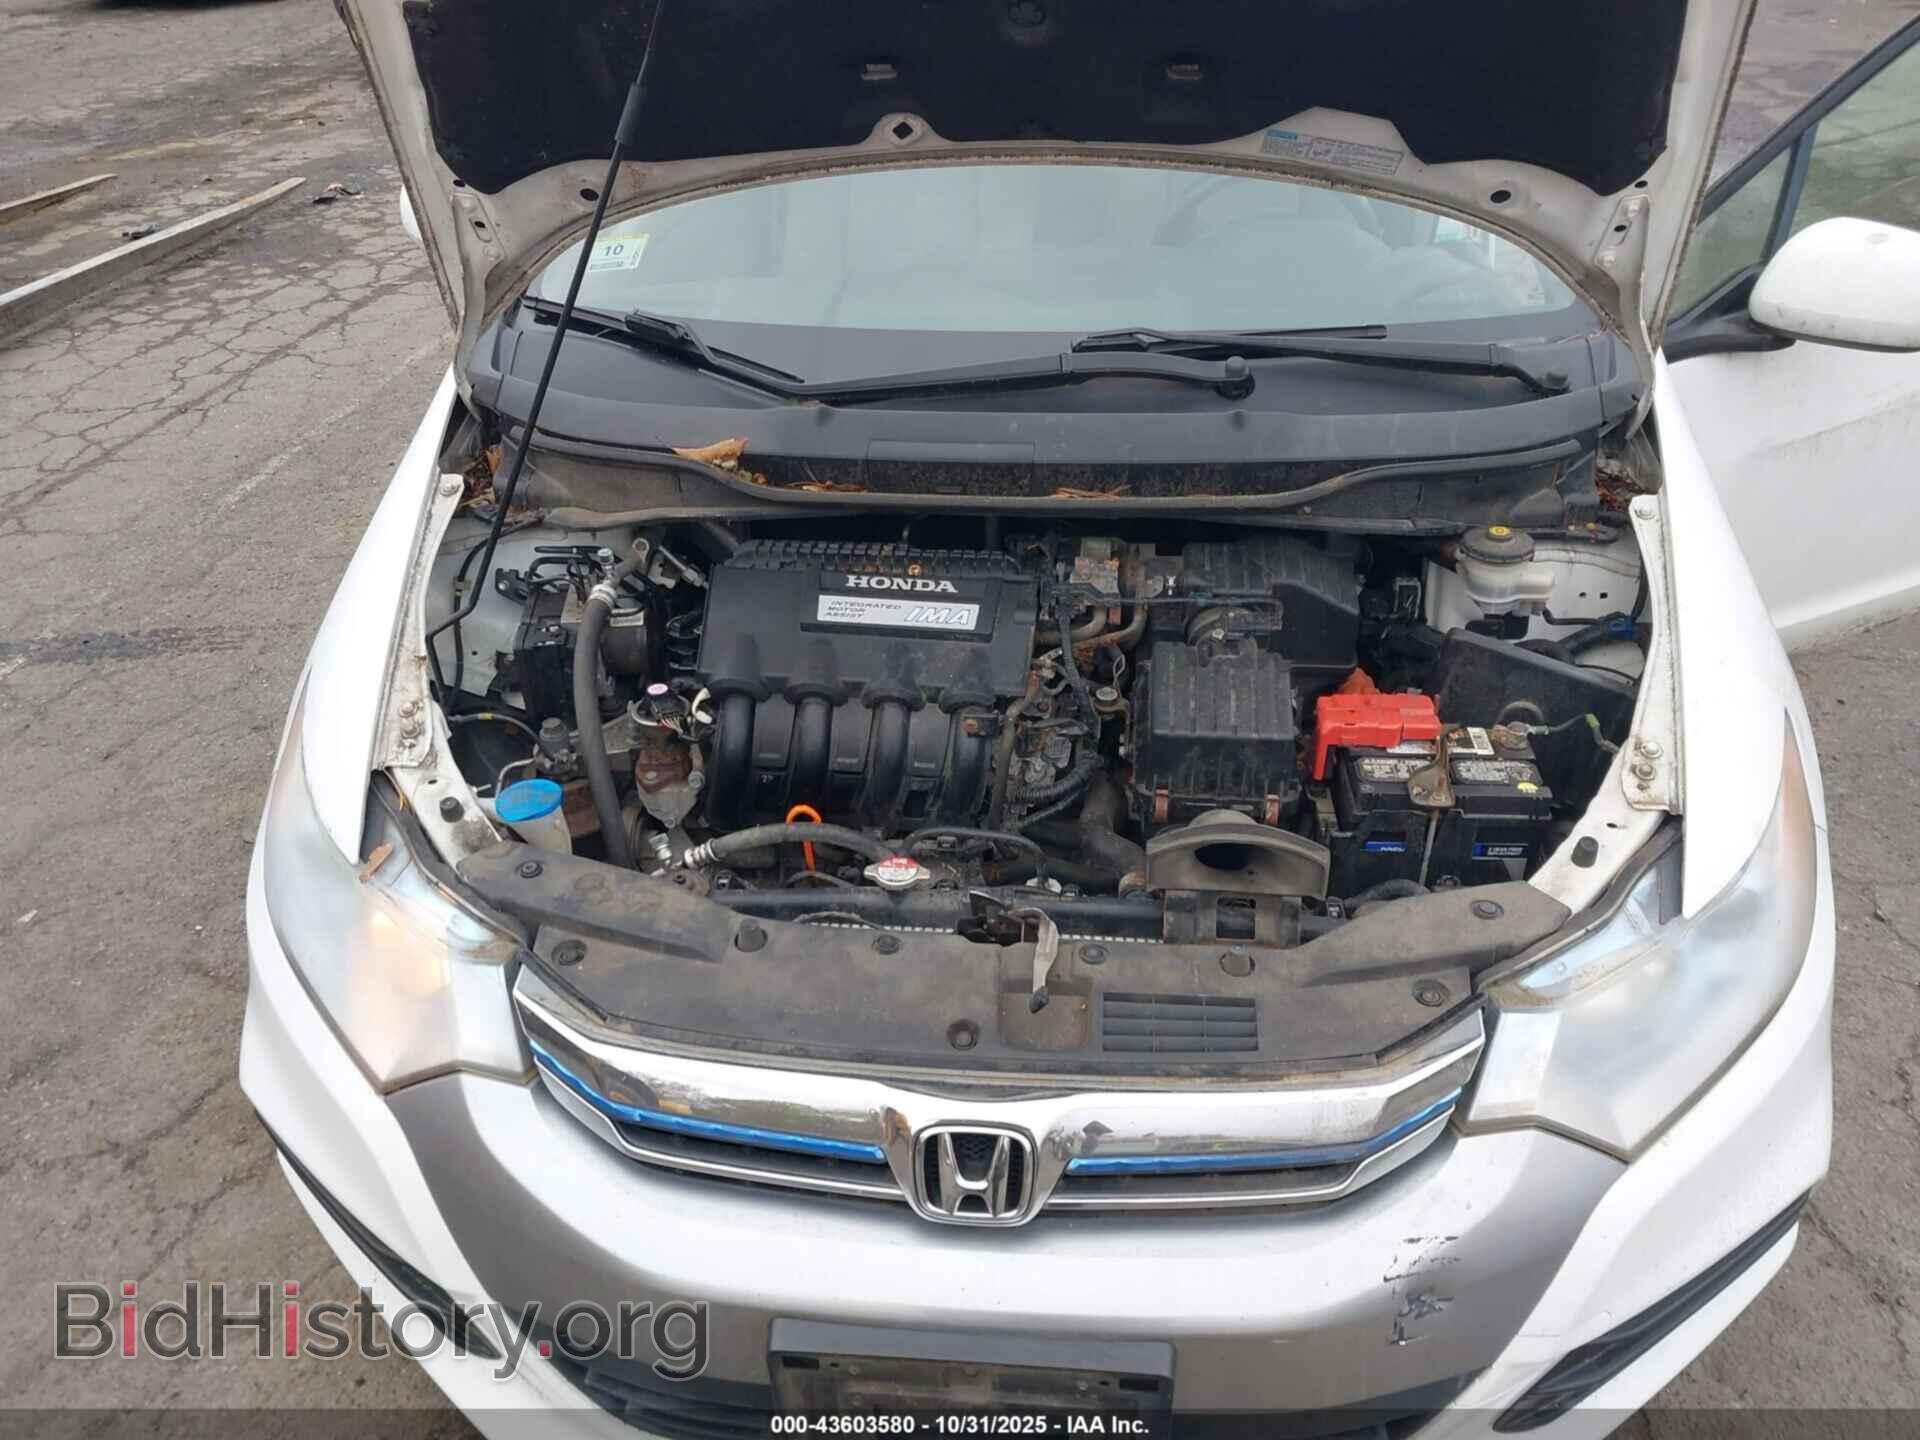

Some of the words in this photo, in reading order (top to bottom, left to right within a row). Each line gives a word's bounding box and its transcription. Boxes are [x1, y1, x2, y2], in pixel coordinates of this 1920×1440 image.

[605, 244, 624, 257] 10
[845, 574, 959, 593] HONDA
[830, 600, 902, 610] INTEGRATED
[904, 605, 972, 625] IMA
